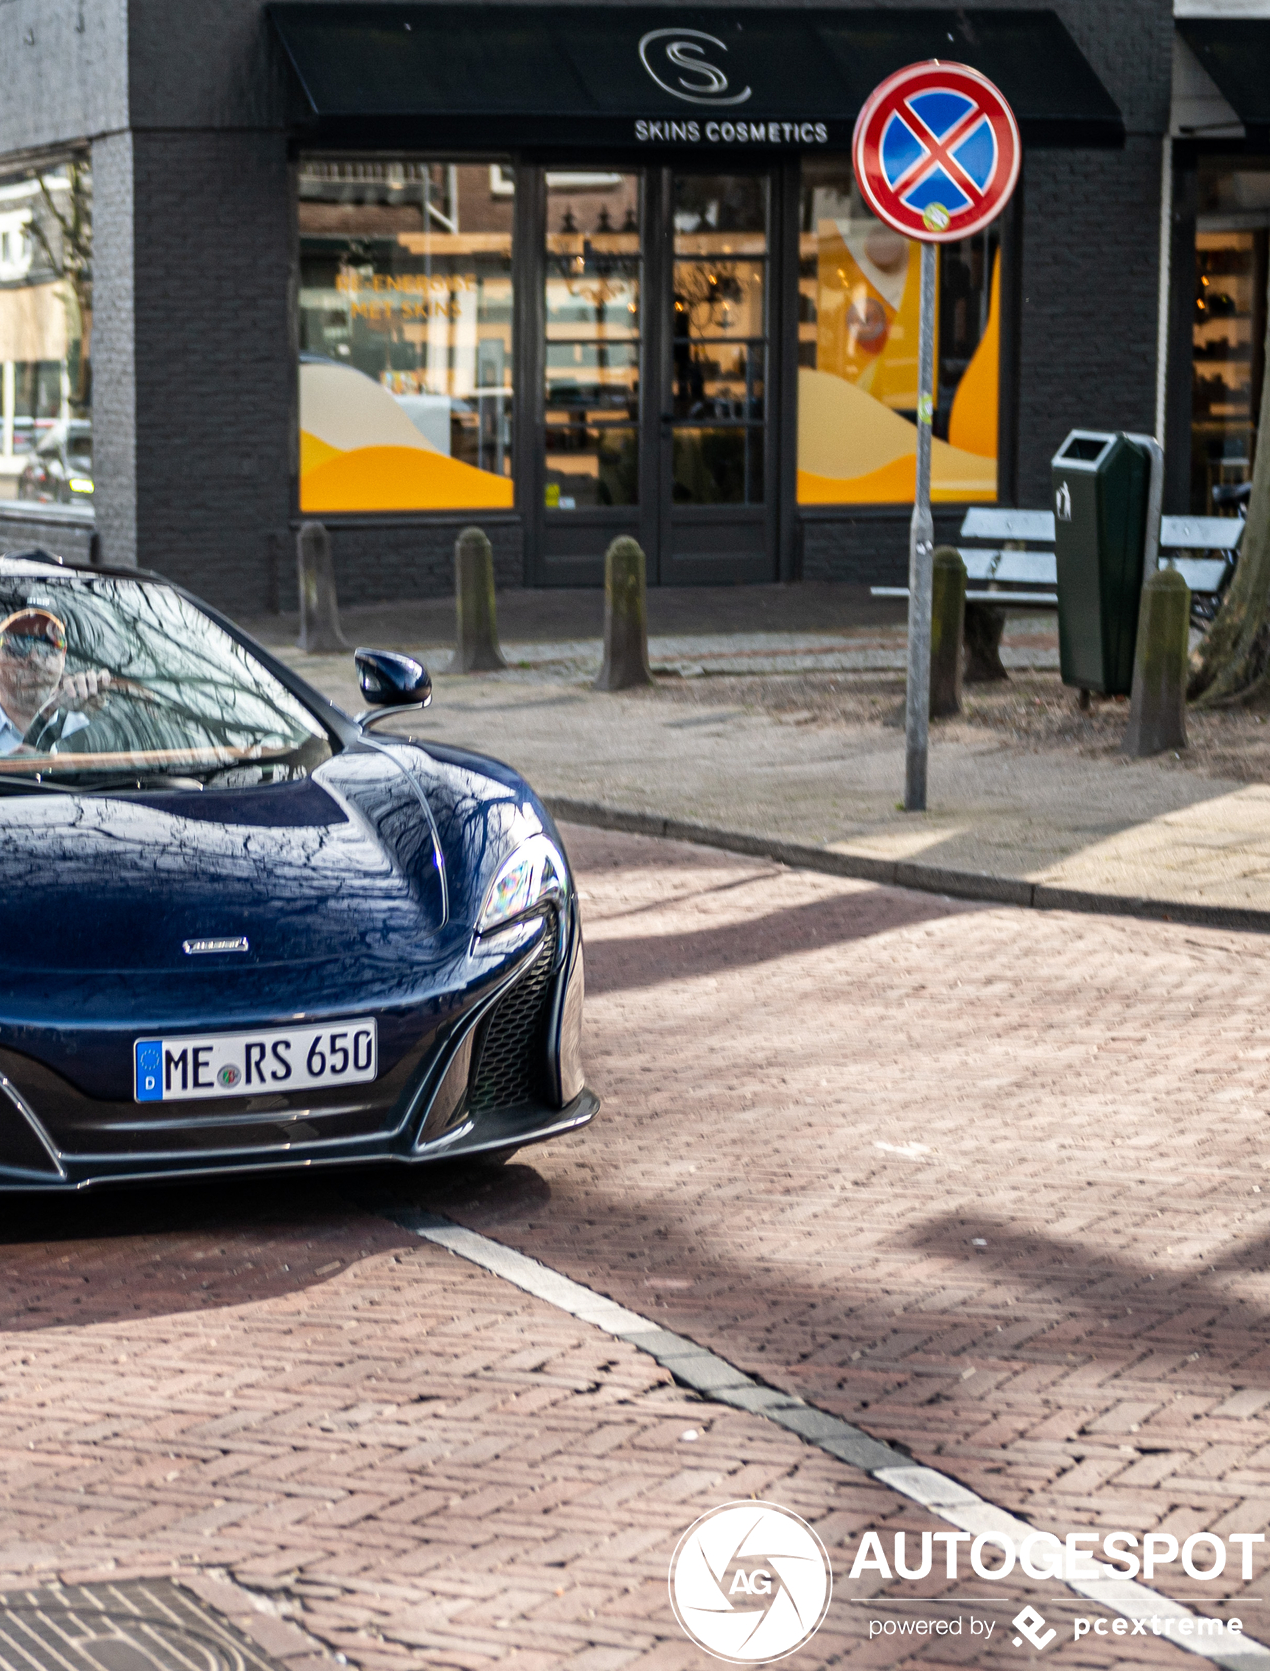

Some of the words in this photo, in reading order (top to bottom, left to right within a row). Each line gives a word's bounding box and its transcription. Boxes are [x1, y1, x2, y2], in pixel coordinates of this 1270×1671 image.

[634, 119, 701, 142] SKINS
[705, 121, 828, 143] COSMETICS
[351, 300, 393, 319] MET
[401, 300, 462, 319] SKINS
[145, 1076, 156, 1090] D
[165, 1047, 215, 1091] ME
[245, 1040, 292, 1085] RS
[307, 1031, 373, 1077] 650
